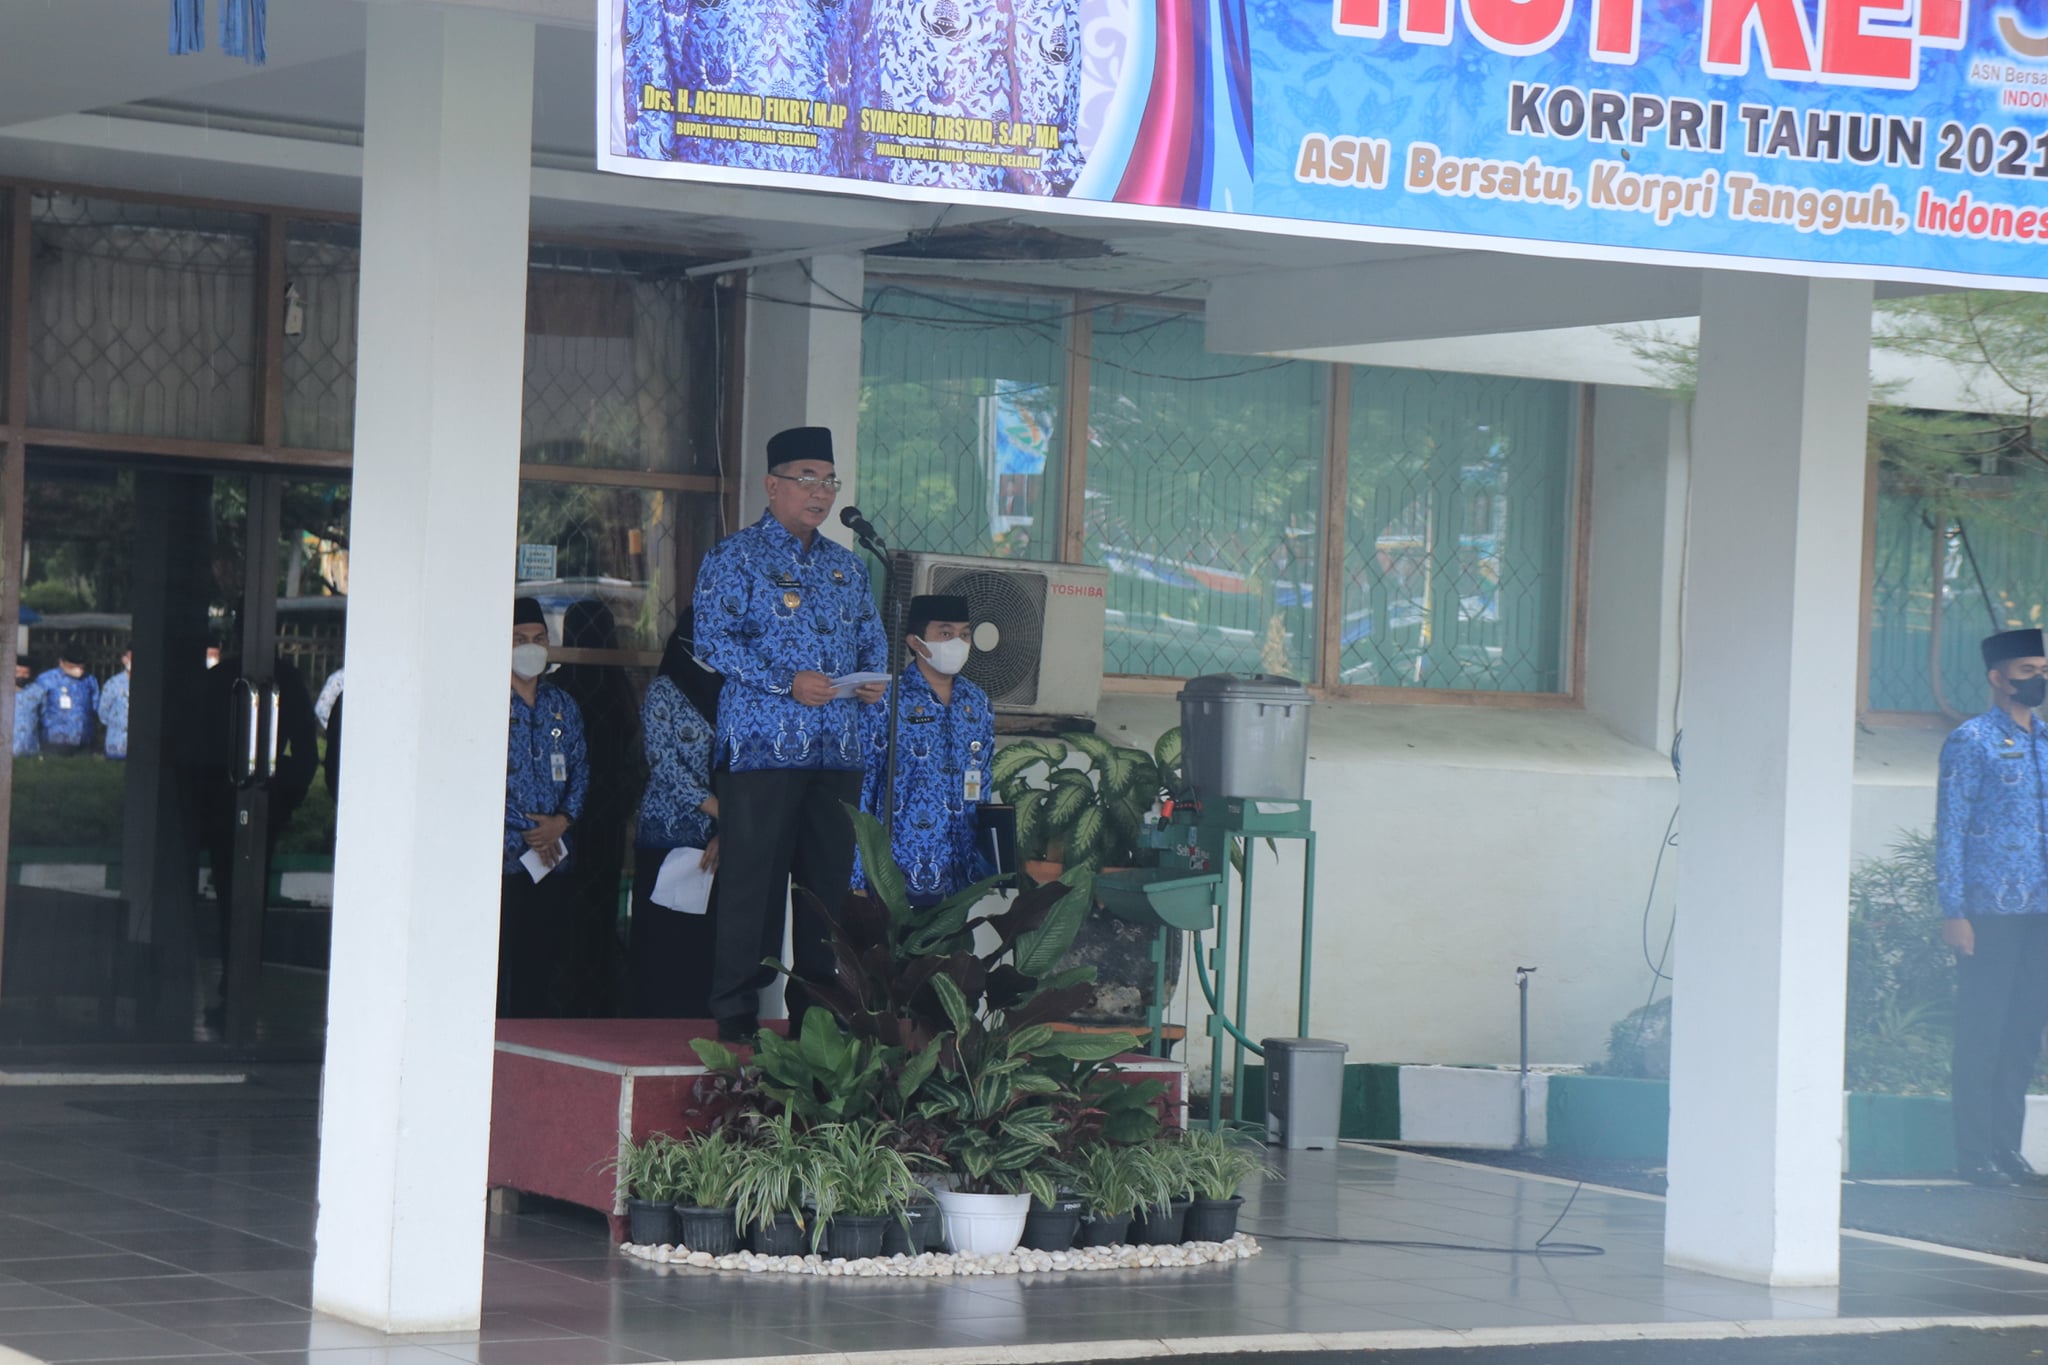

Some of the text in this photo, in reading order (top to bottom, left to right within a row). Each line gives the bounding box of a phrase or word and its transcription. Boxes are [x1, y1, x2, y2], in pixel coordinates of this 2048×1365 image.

[1971, 64, 2000, 81] ASN
[643, 85, 848, 129] Drs. H. ACHMAD FIKRY, M.AP
[676, 122, 818, 148] BUPATI HULU SUNGAI SELATAN
[860, 108, 1060, 149] SYAMSURI ARSYAD, S.AP, MA
[1509, 84, 1724, 152] KORPRI
[1741, 106, 1923, 166] TAHUN
[875, 142, 1041, 169] WAKIL BUPATI HULU SUNGAI SELATAN
[1299, 137, 1387, 185] ASN
[1408, 146, 1580, 204] Bersatu,
[1591, 163, 1716, 221] Korpri
[1728, 176, 1906, 230] Tangguh,
[1051, 584, 1105, 598] TOSHIBA
